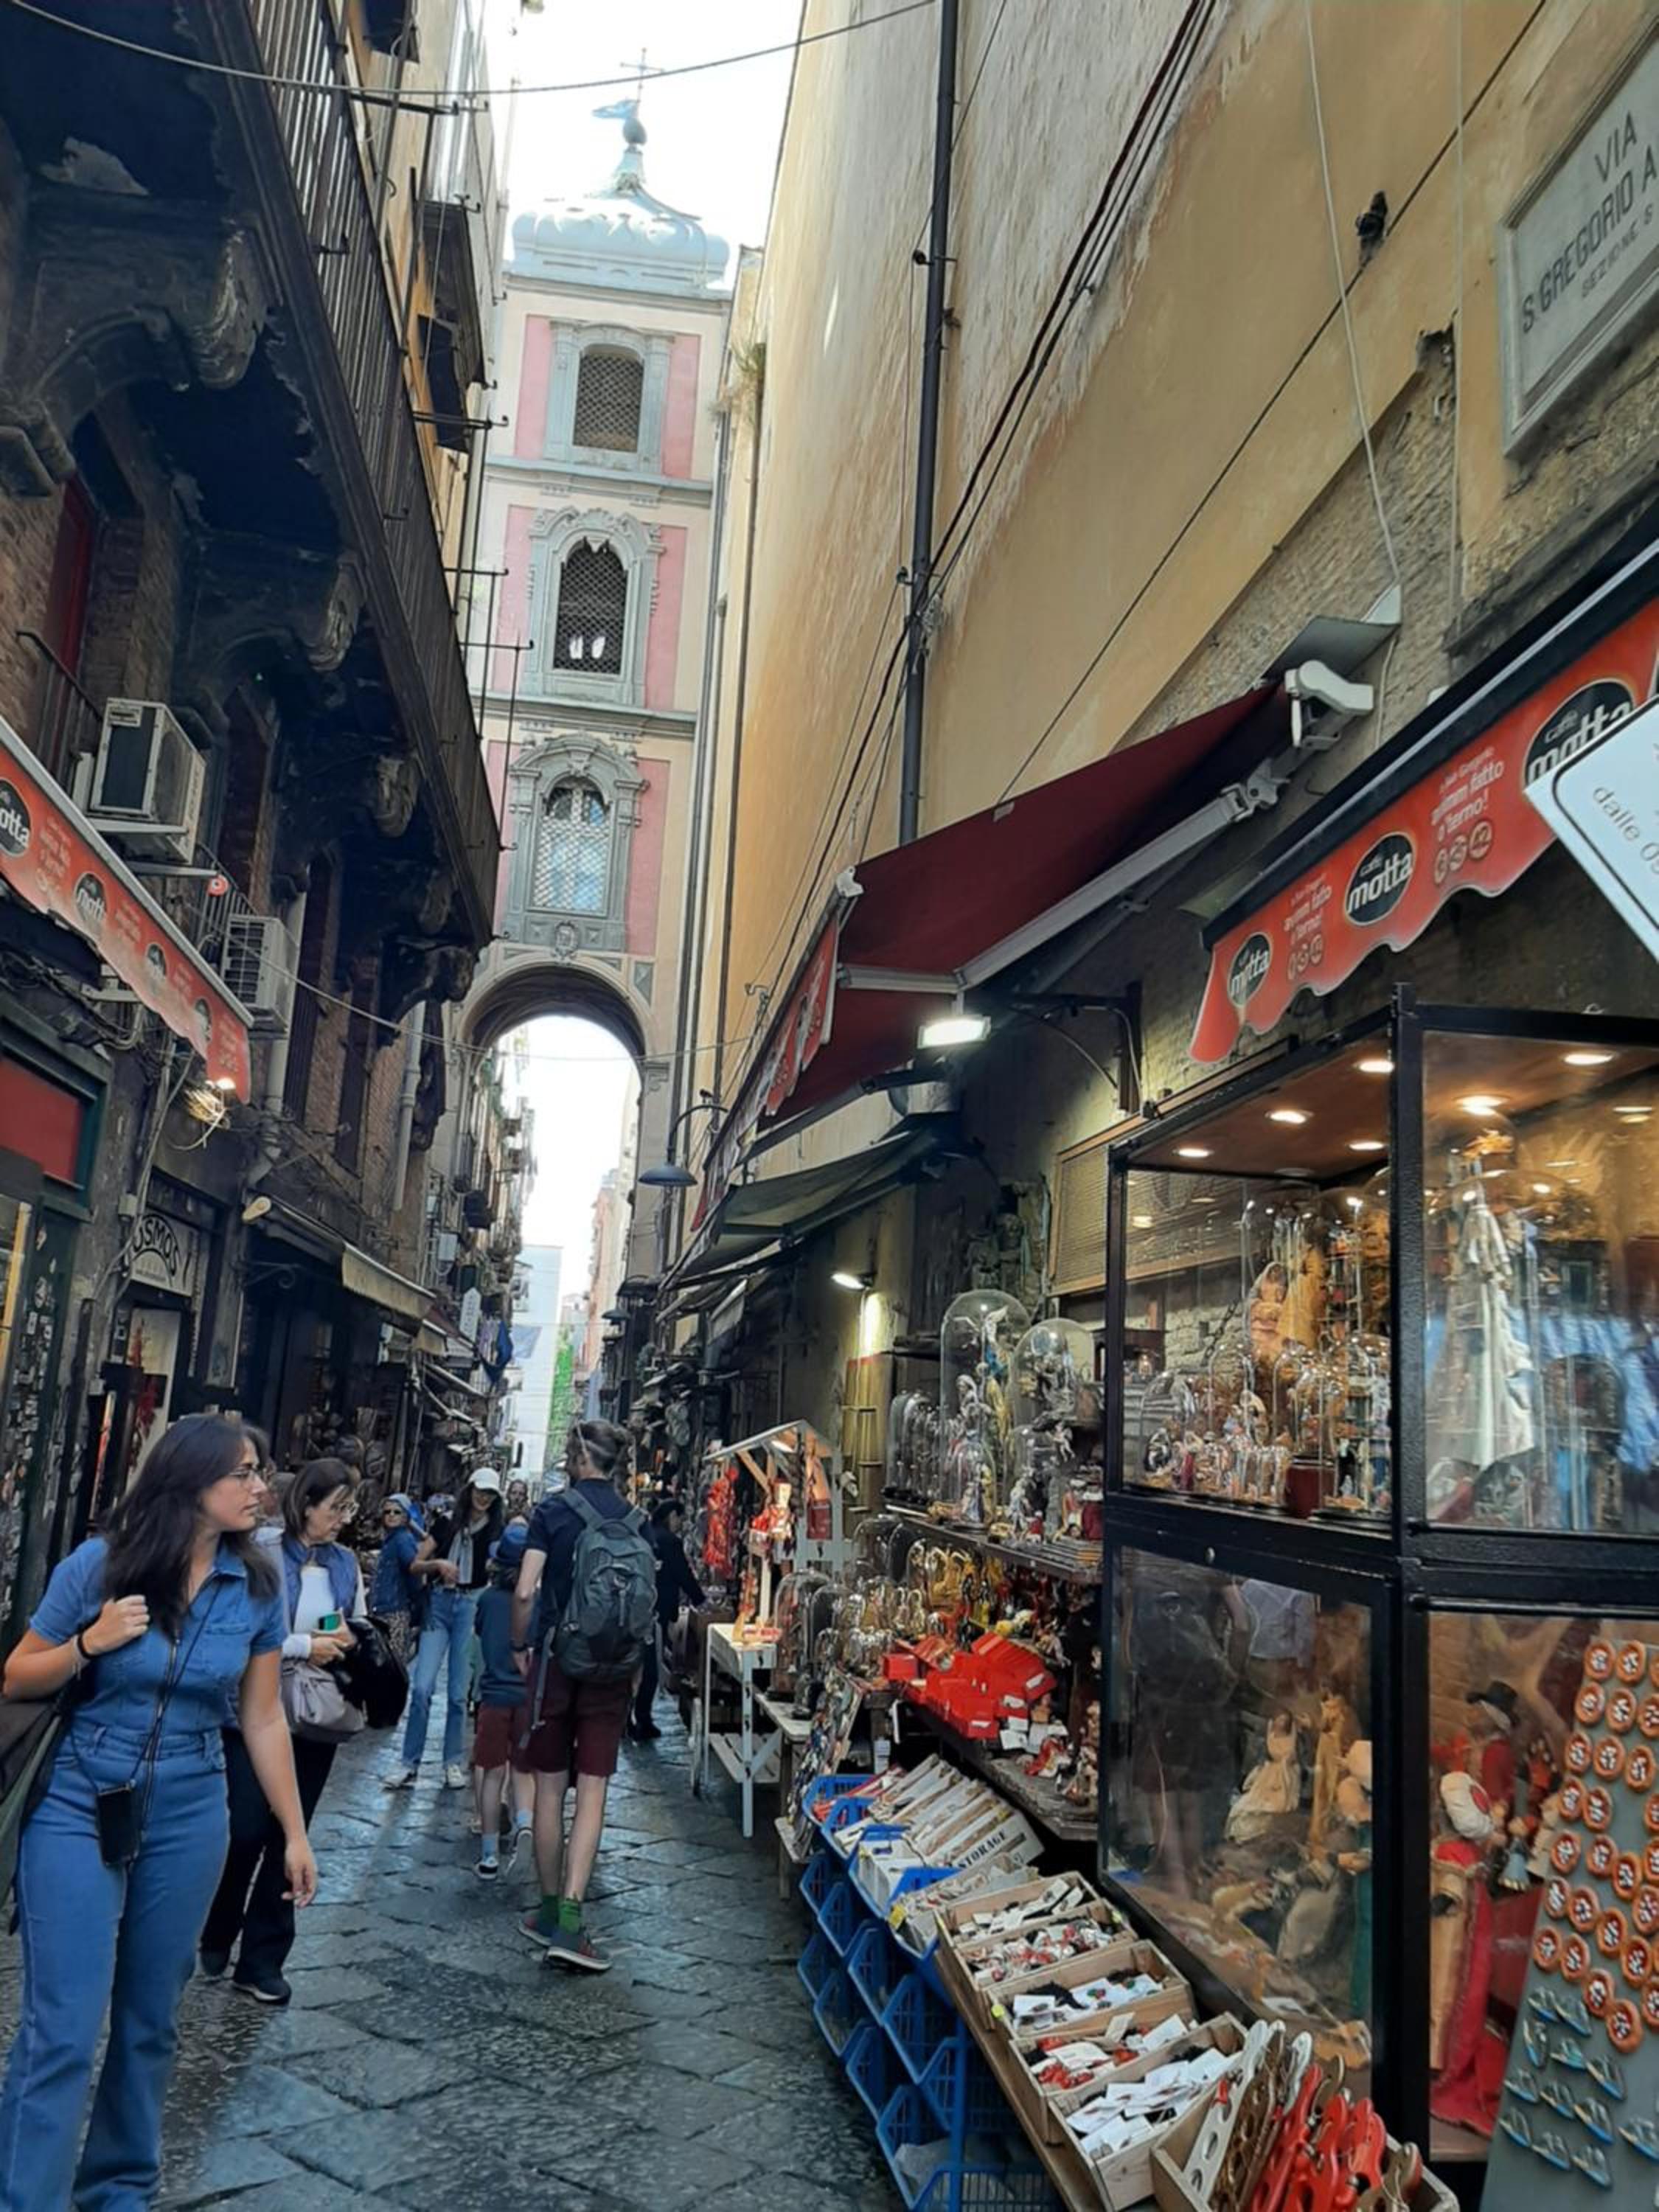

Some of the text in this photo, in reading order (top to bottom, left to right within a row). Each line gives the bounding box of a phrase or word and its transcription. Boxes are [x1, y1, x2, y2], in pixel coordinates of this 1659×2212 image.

[1594, 111, 1638, 183] VIA
[0, 808, 31, 848] otta
[1593, 787, 1641, 842] dalle
[1348, 852, 1412, 914] motta
